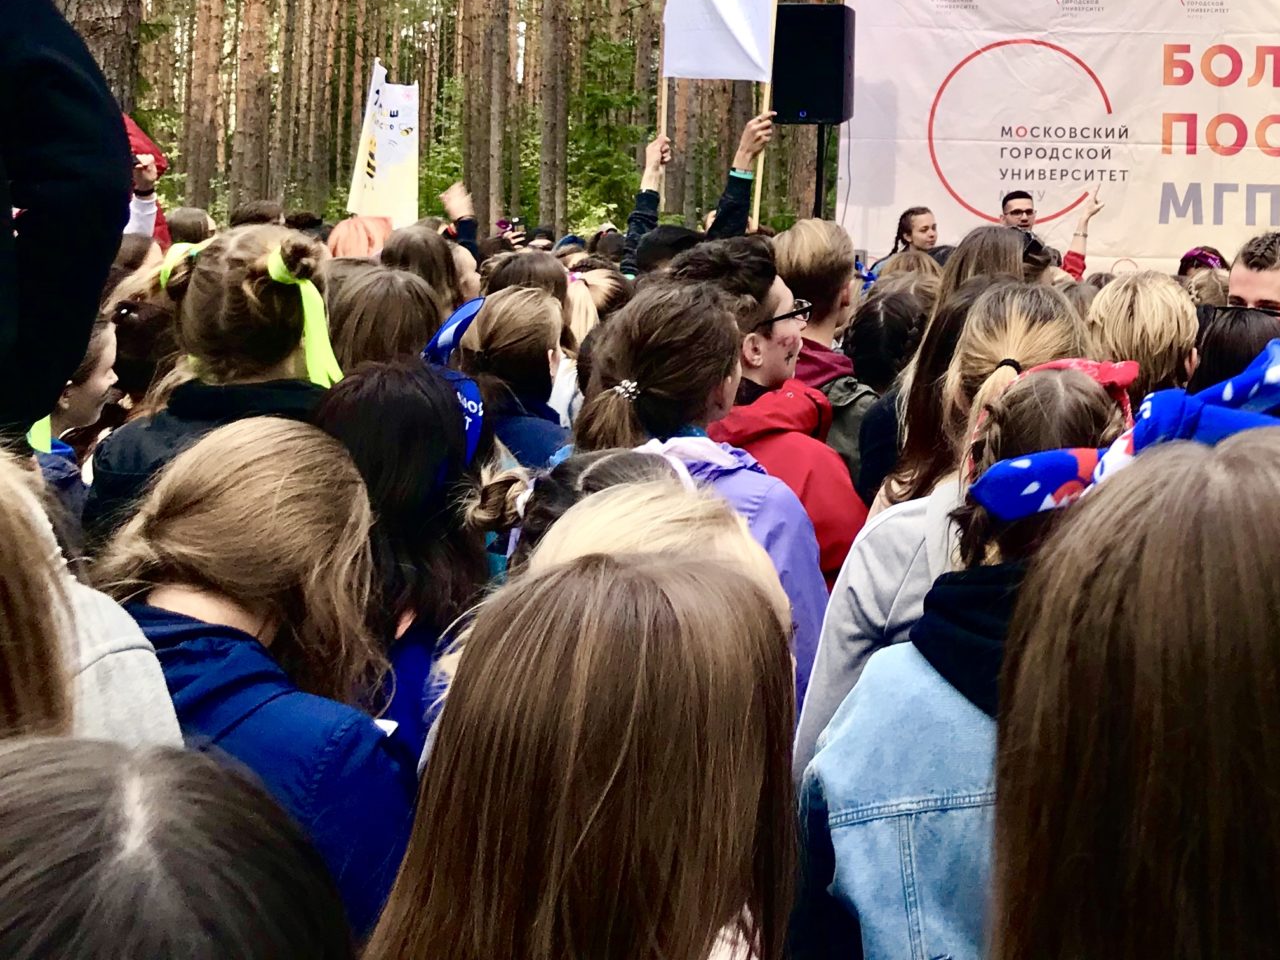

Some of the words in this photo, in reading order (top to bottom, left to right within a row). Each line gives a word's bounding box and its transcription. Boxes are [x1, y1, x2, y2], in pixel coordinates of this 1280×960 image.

[1000, 125, 1129, 139] МОСКОВСКИЙ
[1000, 146, 1112, 161] ГОРОДСКОЙ
[999, 168, 1129, 182] УНИВЕРСИТЕТ
